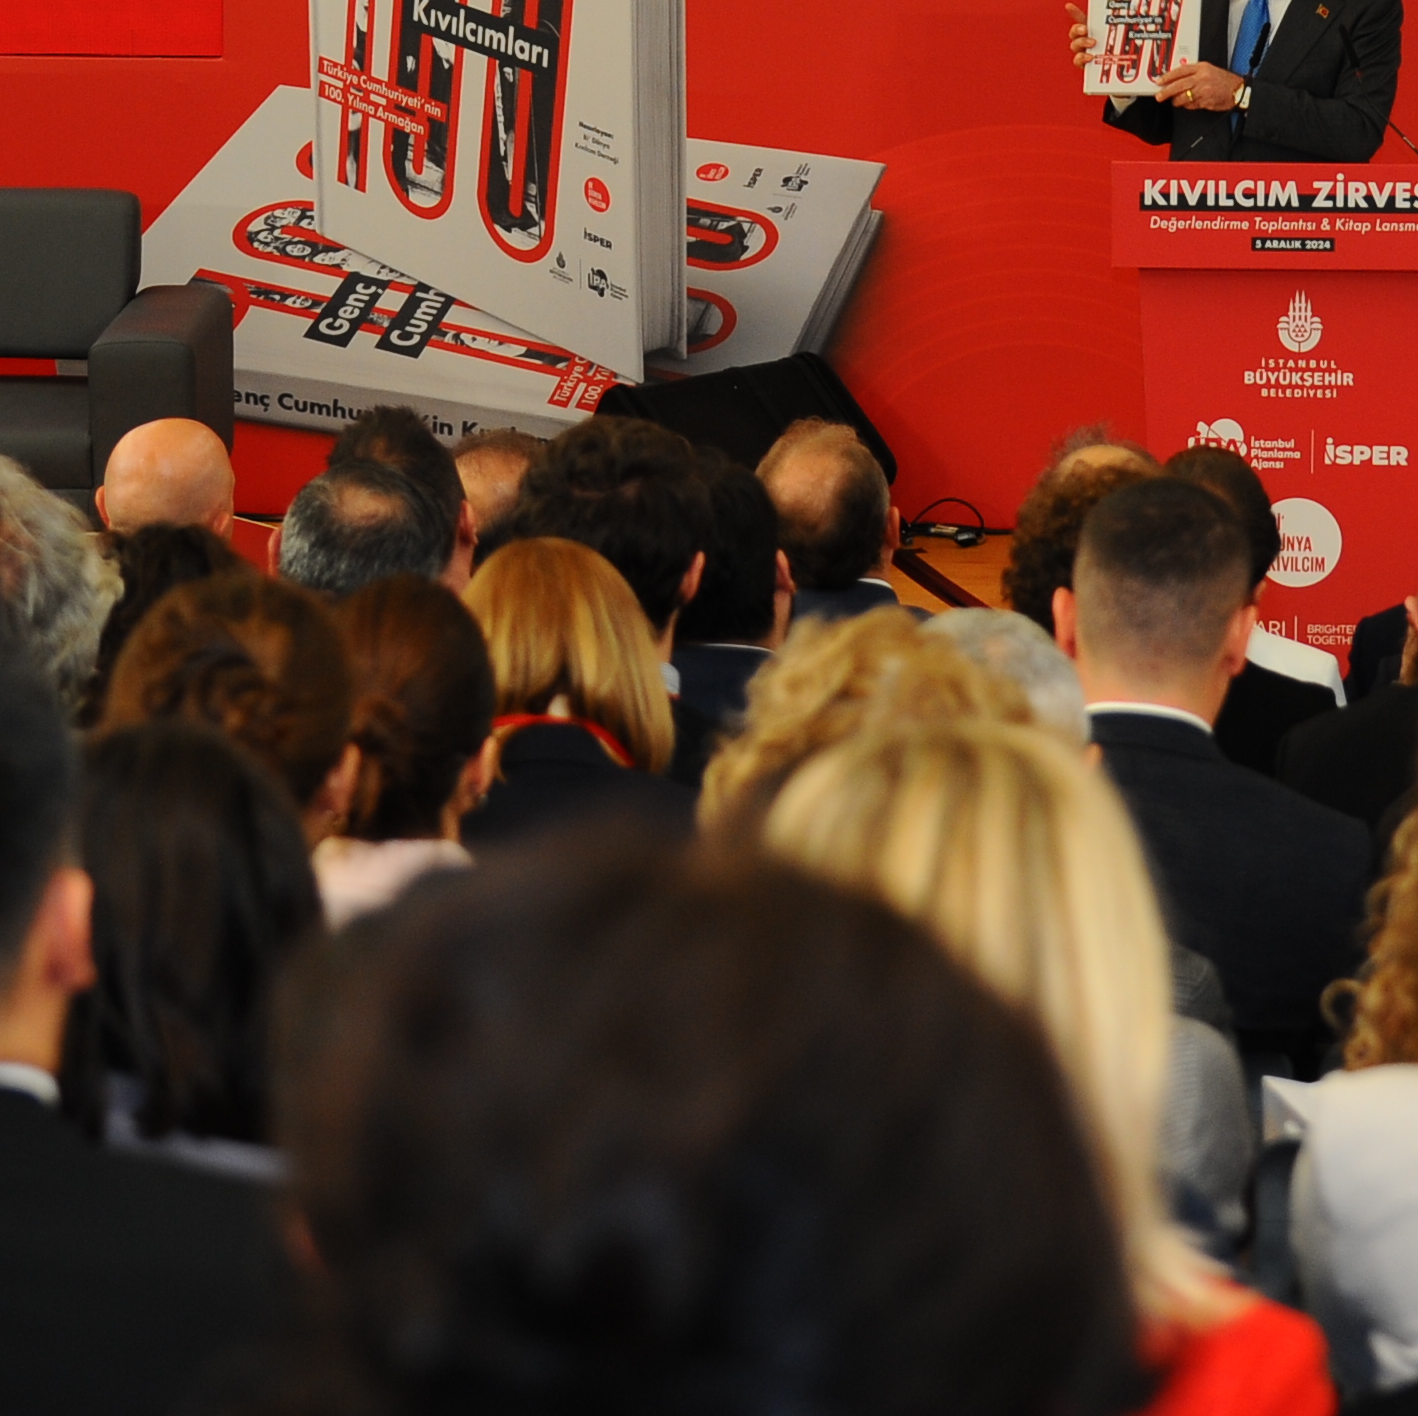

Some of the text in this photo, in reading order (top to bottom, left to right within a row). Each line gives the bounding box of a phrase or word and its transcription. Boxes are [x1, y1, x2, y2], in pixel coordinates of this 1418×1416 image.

[1145, 180, 1299, 207] KIVILCIM
[1150, 216, 1249, 232] Değerlendirme
[1255, 217, 1316, 233] Toplantısı
[1321, 218, 1330, 230] &
[1336, 218, 1371, 234] Kitap
[1256, 240, 1261, 248] 5
[319, 283, 383, 335] Genç
[1244, 369, 1353, 386] BÜYÜKŞEHİR
[1324, 438, 1408, 466] İSPER
